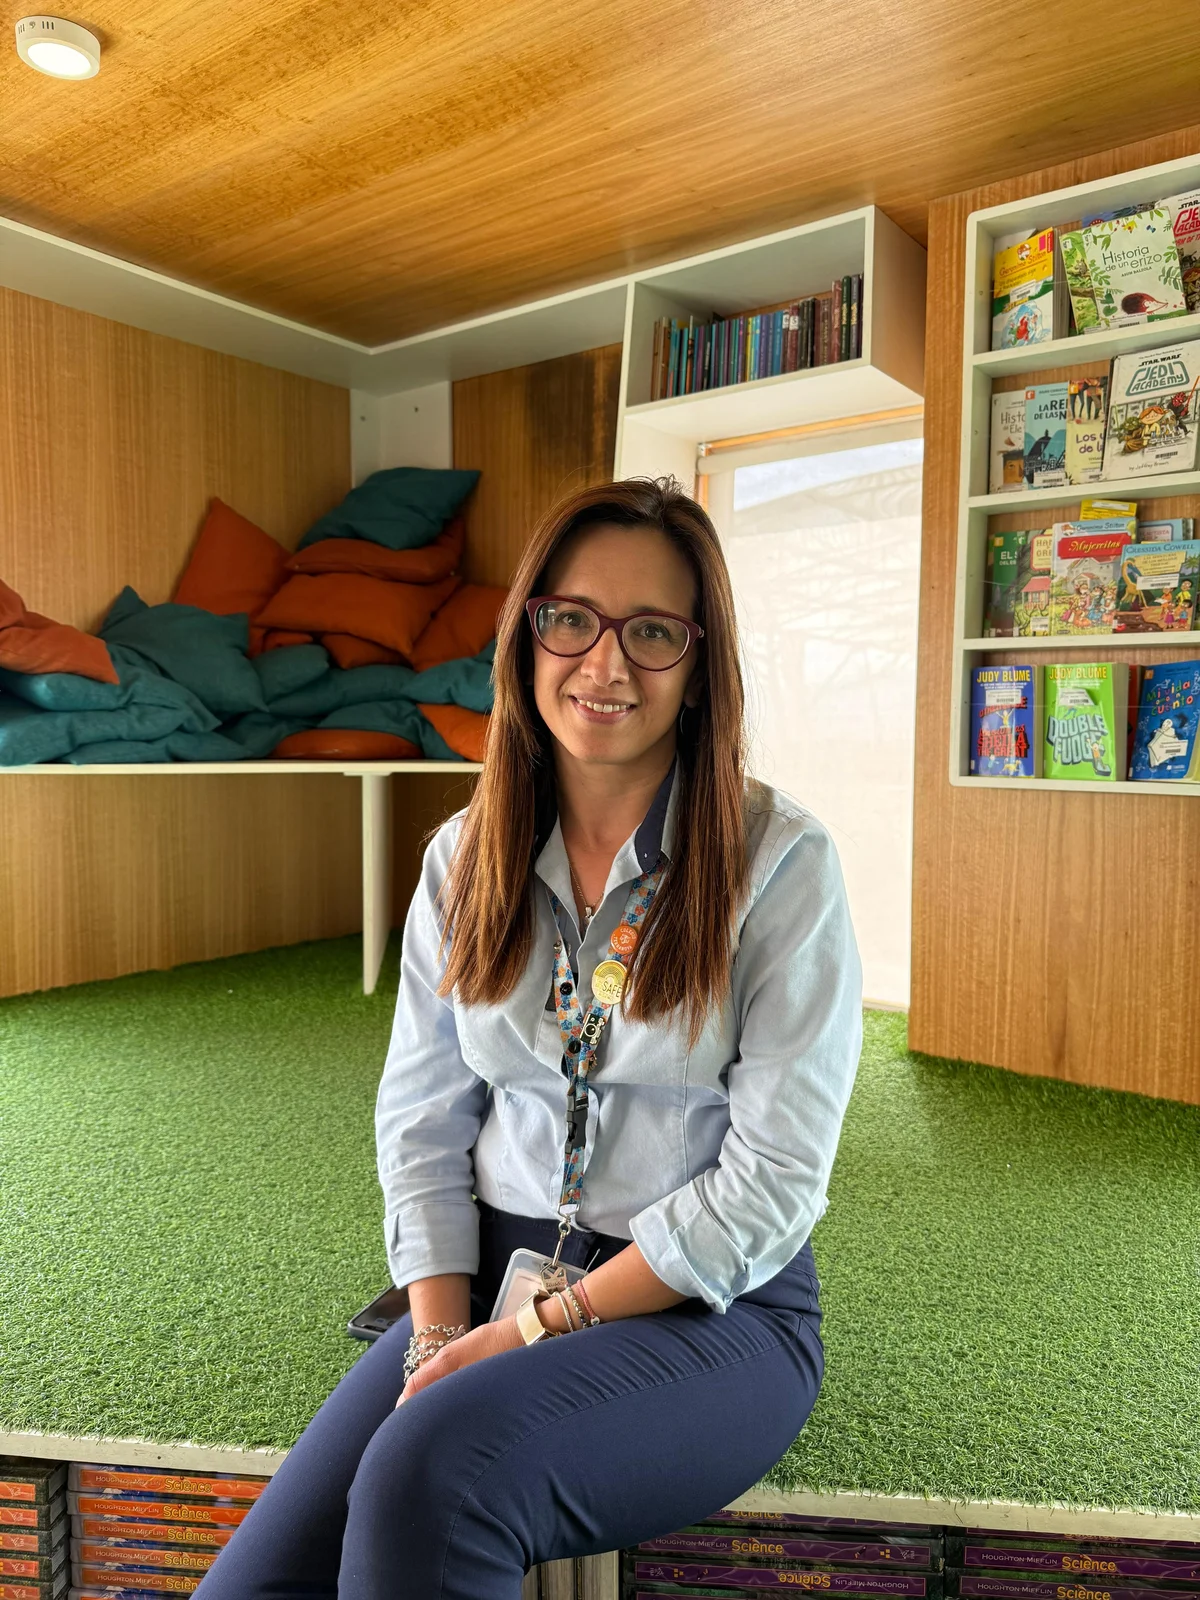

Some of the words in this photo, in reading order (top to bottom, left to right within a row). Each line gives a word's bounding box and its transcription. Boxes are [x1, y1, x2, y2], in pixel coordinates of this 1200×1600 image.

[1102, 246, 1149, 265] Historia
[1130, 254, 1163, 268] erizo
[1138, 358, 1160, 367] STAR
[1160, 353, 1181, 362] WARS
[1137, 362, 1174, 382] JEDI
[1039, 404, 1049, 412] LA
[1034, 412, 1044, 420] DE
[1045, 411, 1058, 419] LAS
[1068, 540, 1121, 553] Mujercitas
[976, 671, 999, 683] JUDY
[1002, 670, 1031, 682] BLUME
[1049, 668, 1073, 680] JUDY
[1076, 667, 1107, 679] BLUME
[1047, 714, 1108, 746] DOUBLE
[602, 981, 622, 998] SAFE
[165, 1478, 213, 1493] Science
[163, 1505, 210, 1520] Science
[167, 1528, 216, 1542] Science
[731, 1539, 784, 1553] Science
[164, 1553, 211, 1567] Science
[981, 1553, 1026, 1563] HOUGHTON
[1061, 1555, 1117, 1572] Science
[778, 1572, 831, 1588] Science
[977, 1583, 1020, 1592] HOUGHTON
[1057, 1586, 1111, 1600] Science
